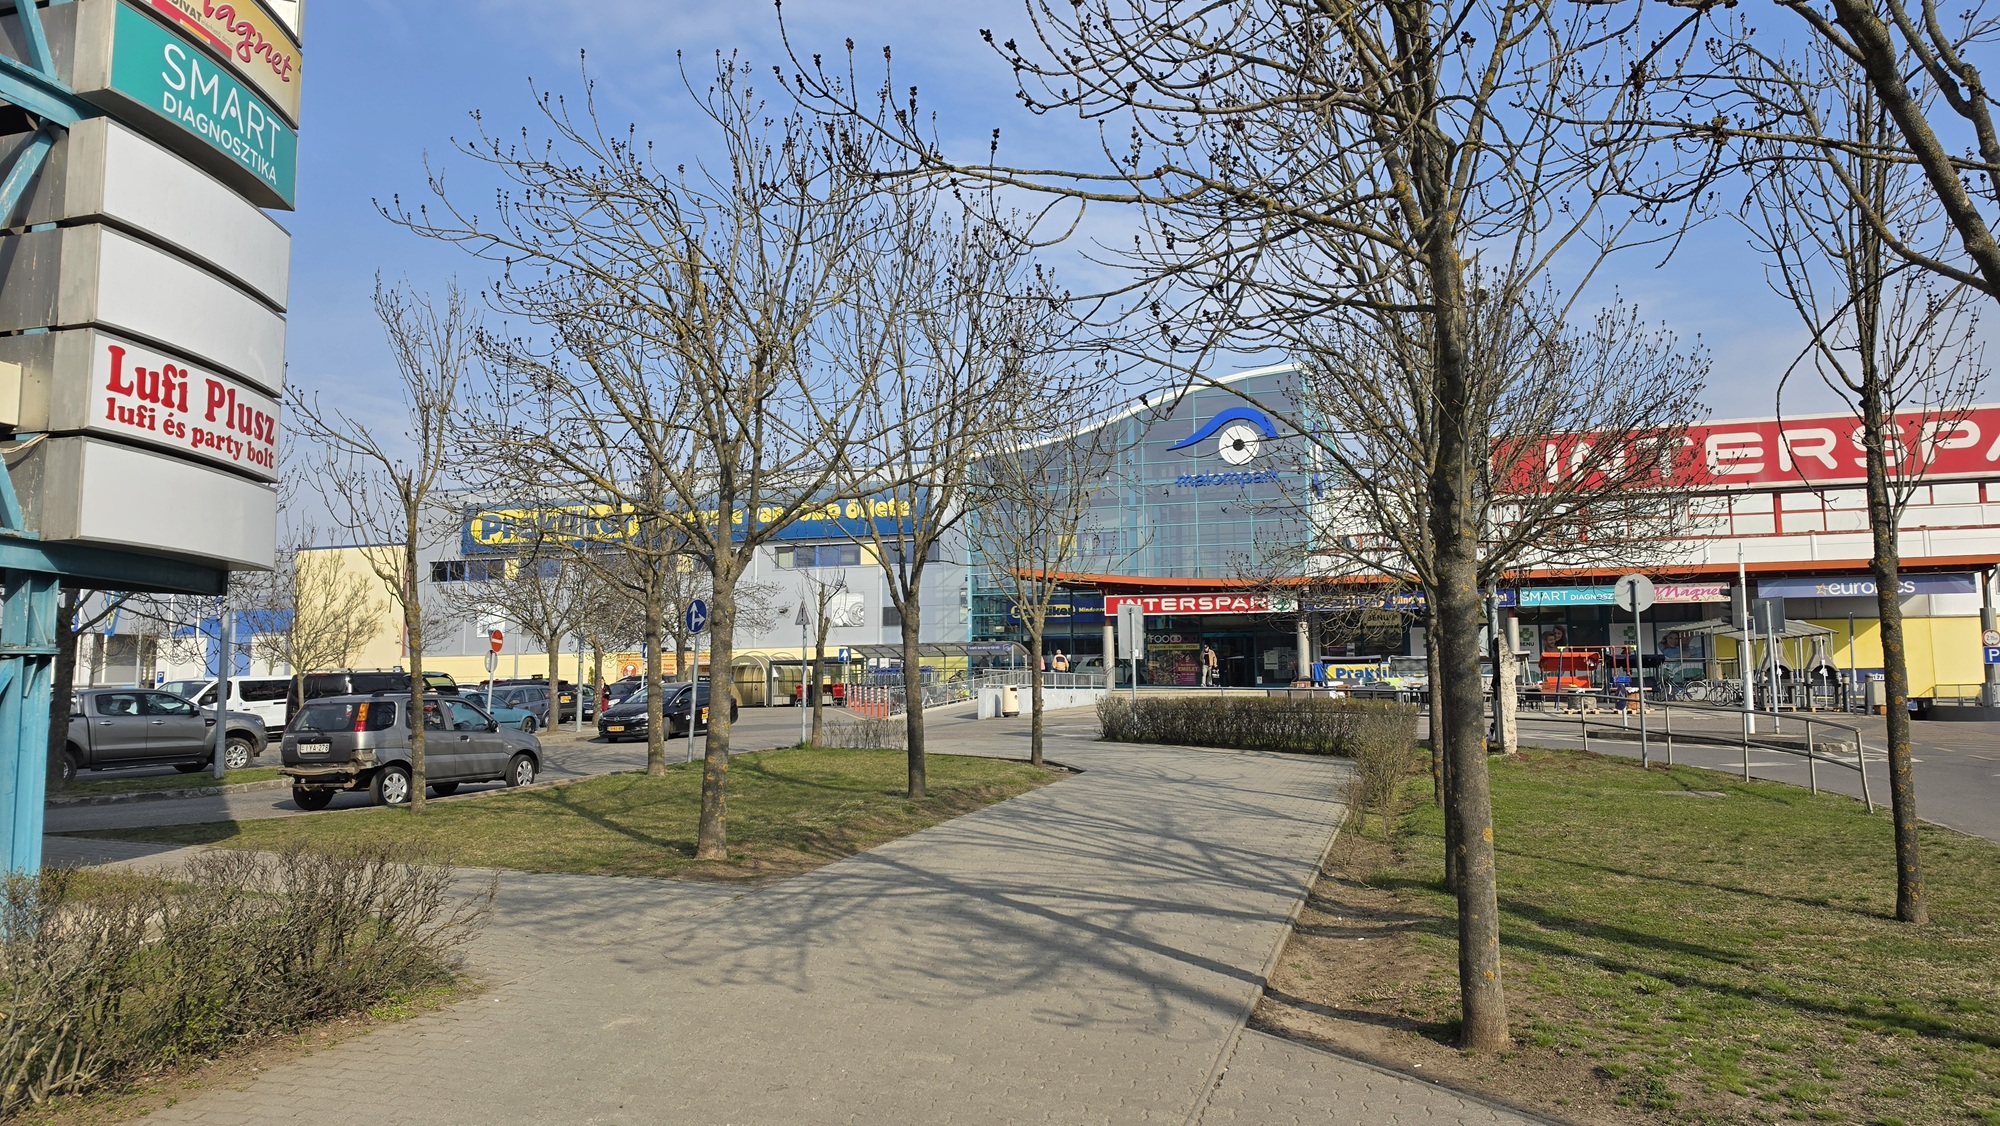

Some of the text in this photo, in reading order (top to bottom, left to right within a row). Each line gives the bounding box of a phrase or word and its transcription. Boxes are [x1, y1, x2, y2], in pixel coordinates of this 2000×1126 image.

[202, 0, 292, 82] agnet
[162, 43, 281, 158] SMART
[163, 91, 277, 185] DIAGNOSZTIKA
[106, 345, 275, 446] Lufi Plusz
[106, 397, 274, 470] lufi és party bolt
[1545, 418, 2000, 484] INTERSP
[1522, 590, 1614, 602] SMART DIAGNOSZ
[1828, 581, 1916, 595] eurocs
[158, 672, 164, 681] P
[1988, 648, 2000, 661] P
